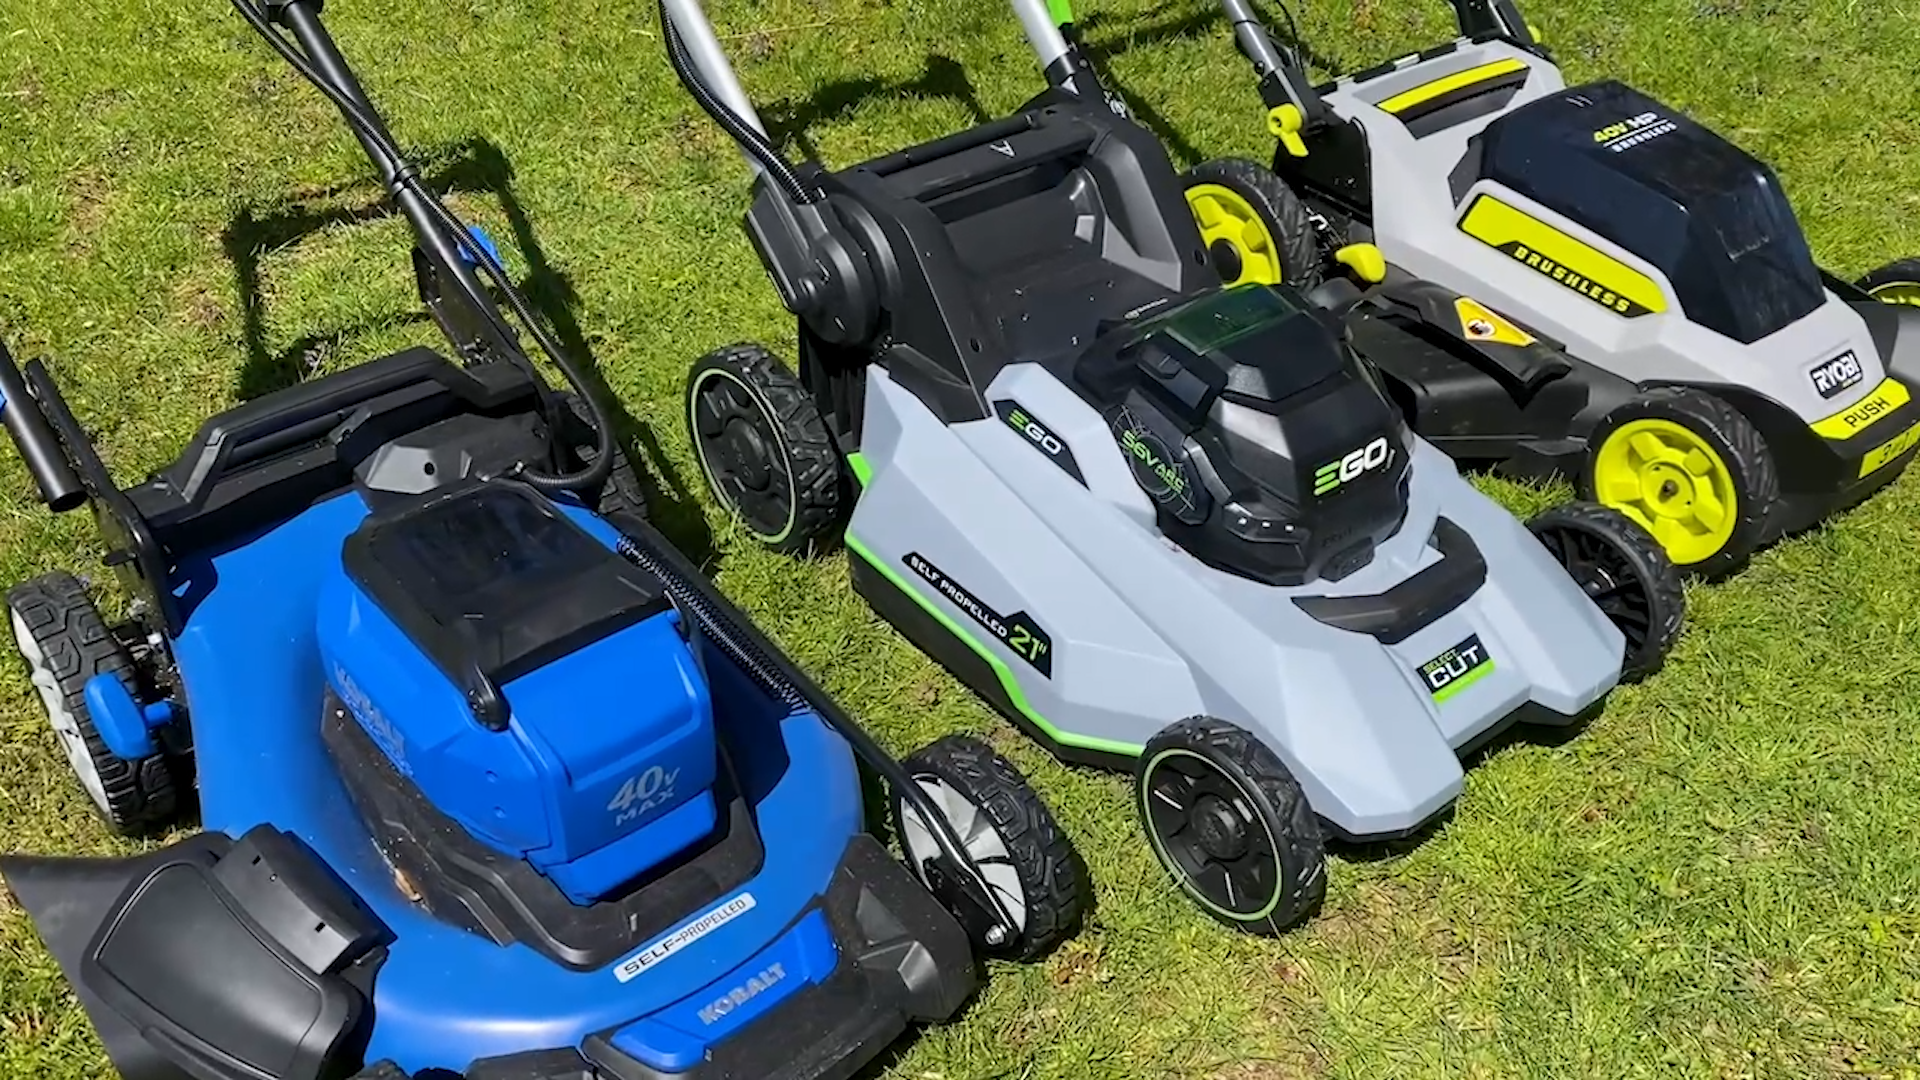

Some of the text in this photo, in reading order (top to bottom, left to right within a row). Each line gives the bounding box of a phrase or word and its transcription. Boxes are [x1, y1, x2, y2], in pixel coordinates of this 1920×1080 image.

[1593, 121, 1628, 142] 40V
[1513, 245, 1630, 312] BRUSHLESS
[1812, 353, 1860, 392] RYOBI
[1008, 409, 1062, 455] EGO
[1843, 397, 1891, 428] PUSH
[1122, 429, 1160, 467] 56V
[1313, 437, 1388, 496] EGO
[910, 555, 940, 582] SELF
[940, 579, 1008, 638] PROPELLED
[1428, 644, 1479, 688] CUT
[615, 785, 675, 827] MAX
[624, 899, 747, 975] SELF-PROPELLED
[697, 961, 787, 1026] KOBALT
